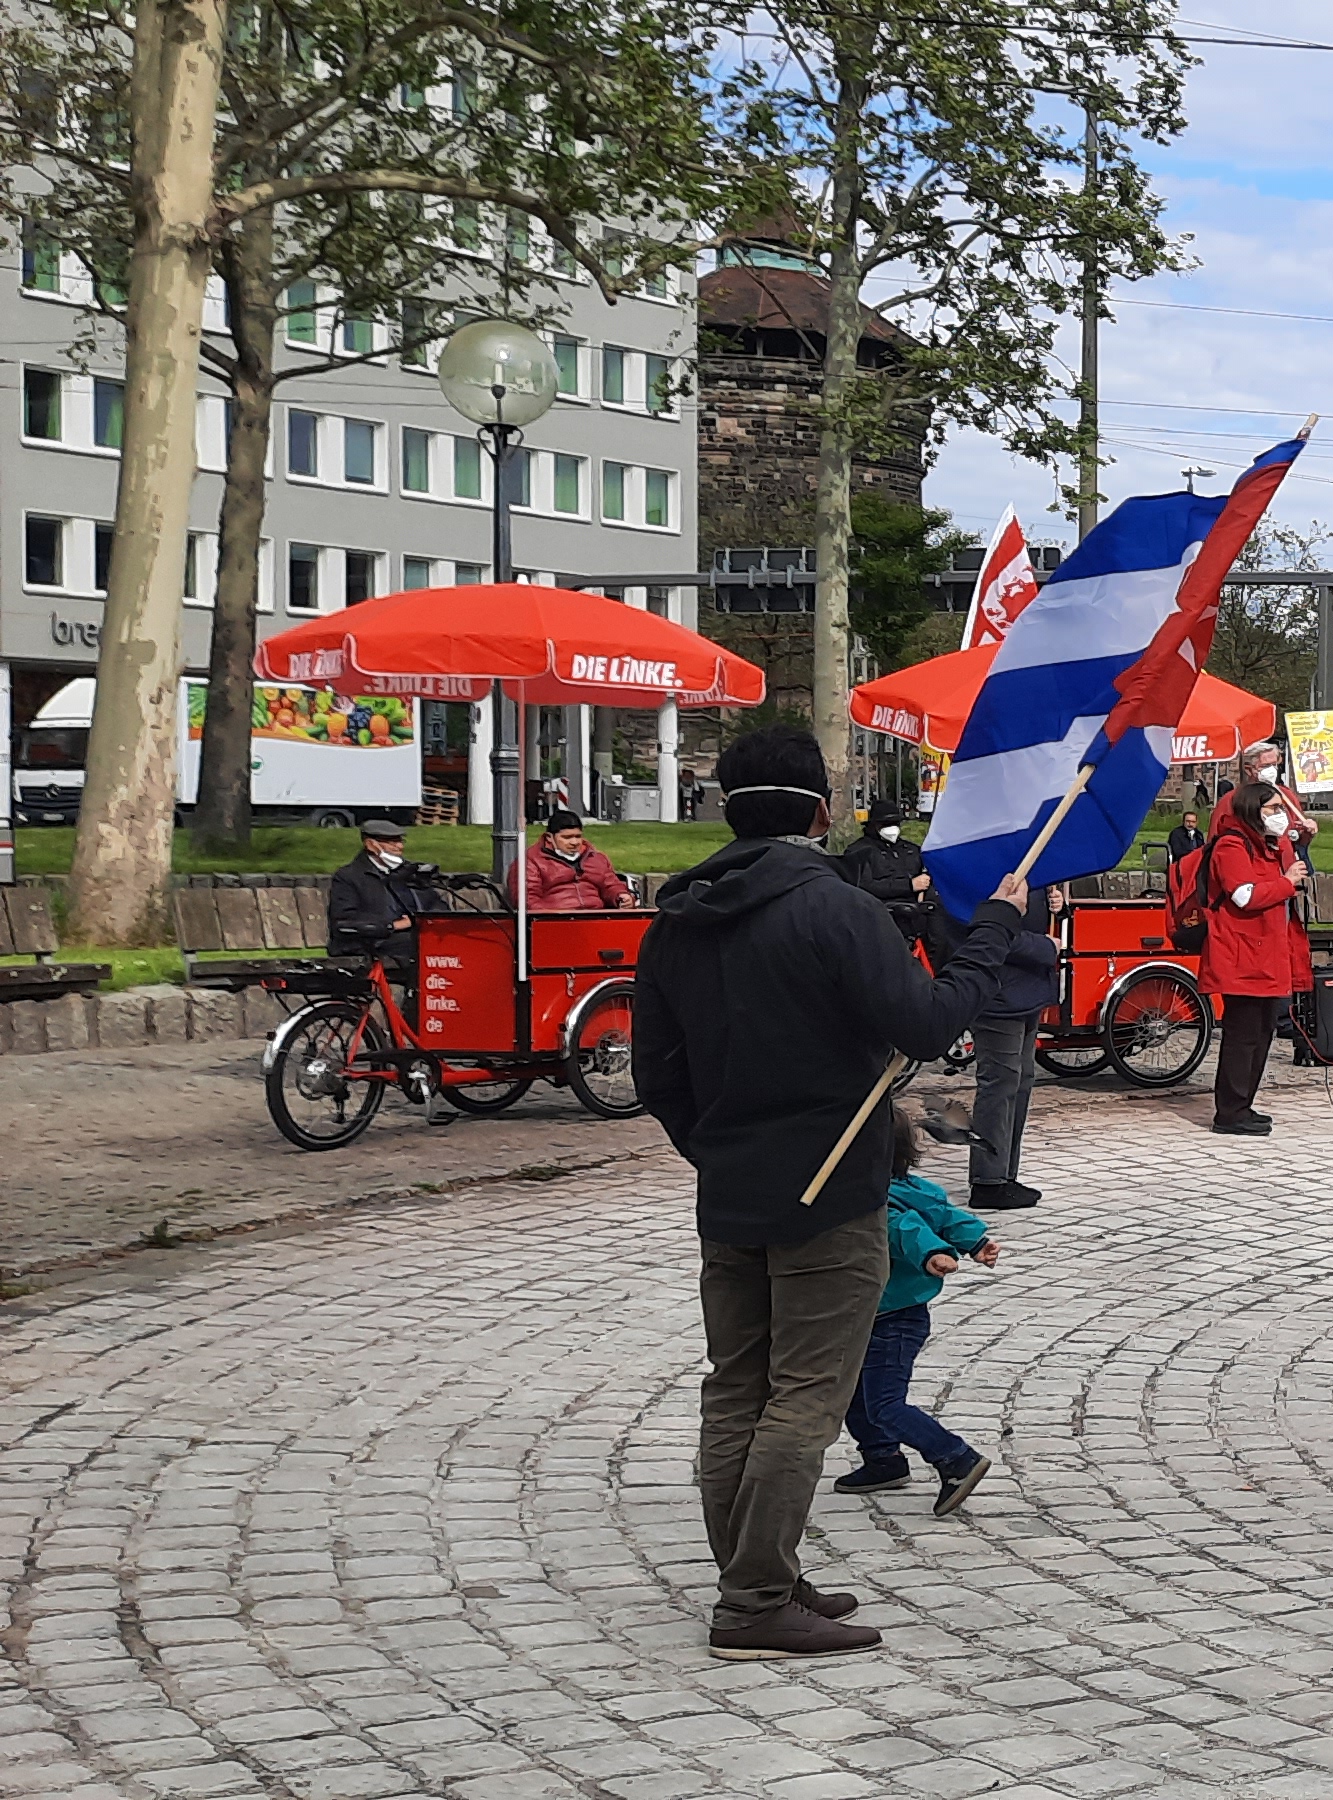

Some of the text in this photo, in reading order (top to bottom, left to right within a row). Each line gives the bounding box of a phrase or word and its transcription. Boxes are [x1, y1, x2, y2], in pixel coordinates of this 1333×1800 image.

[572, 654, 684, 688] DIE LINKE.
[871, 704, 894, 731] DIE
[425, 955, 464, 969] www.
[425, 973, 455, 990] die-
[425, 994, 461, 1011] linke.
[425, 1015, 443, 1033] de
